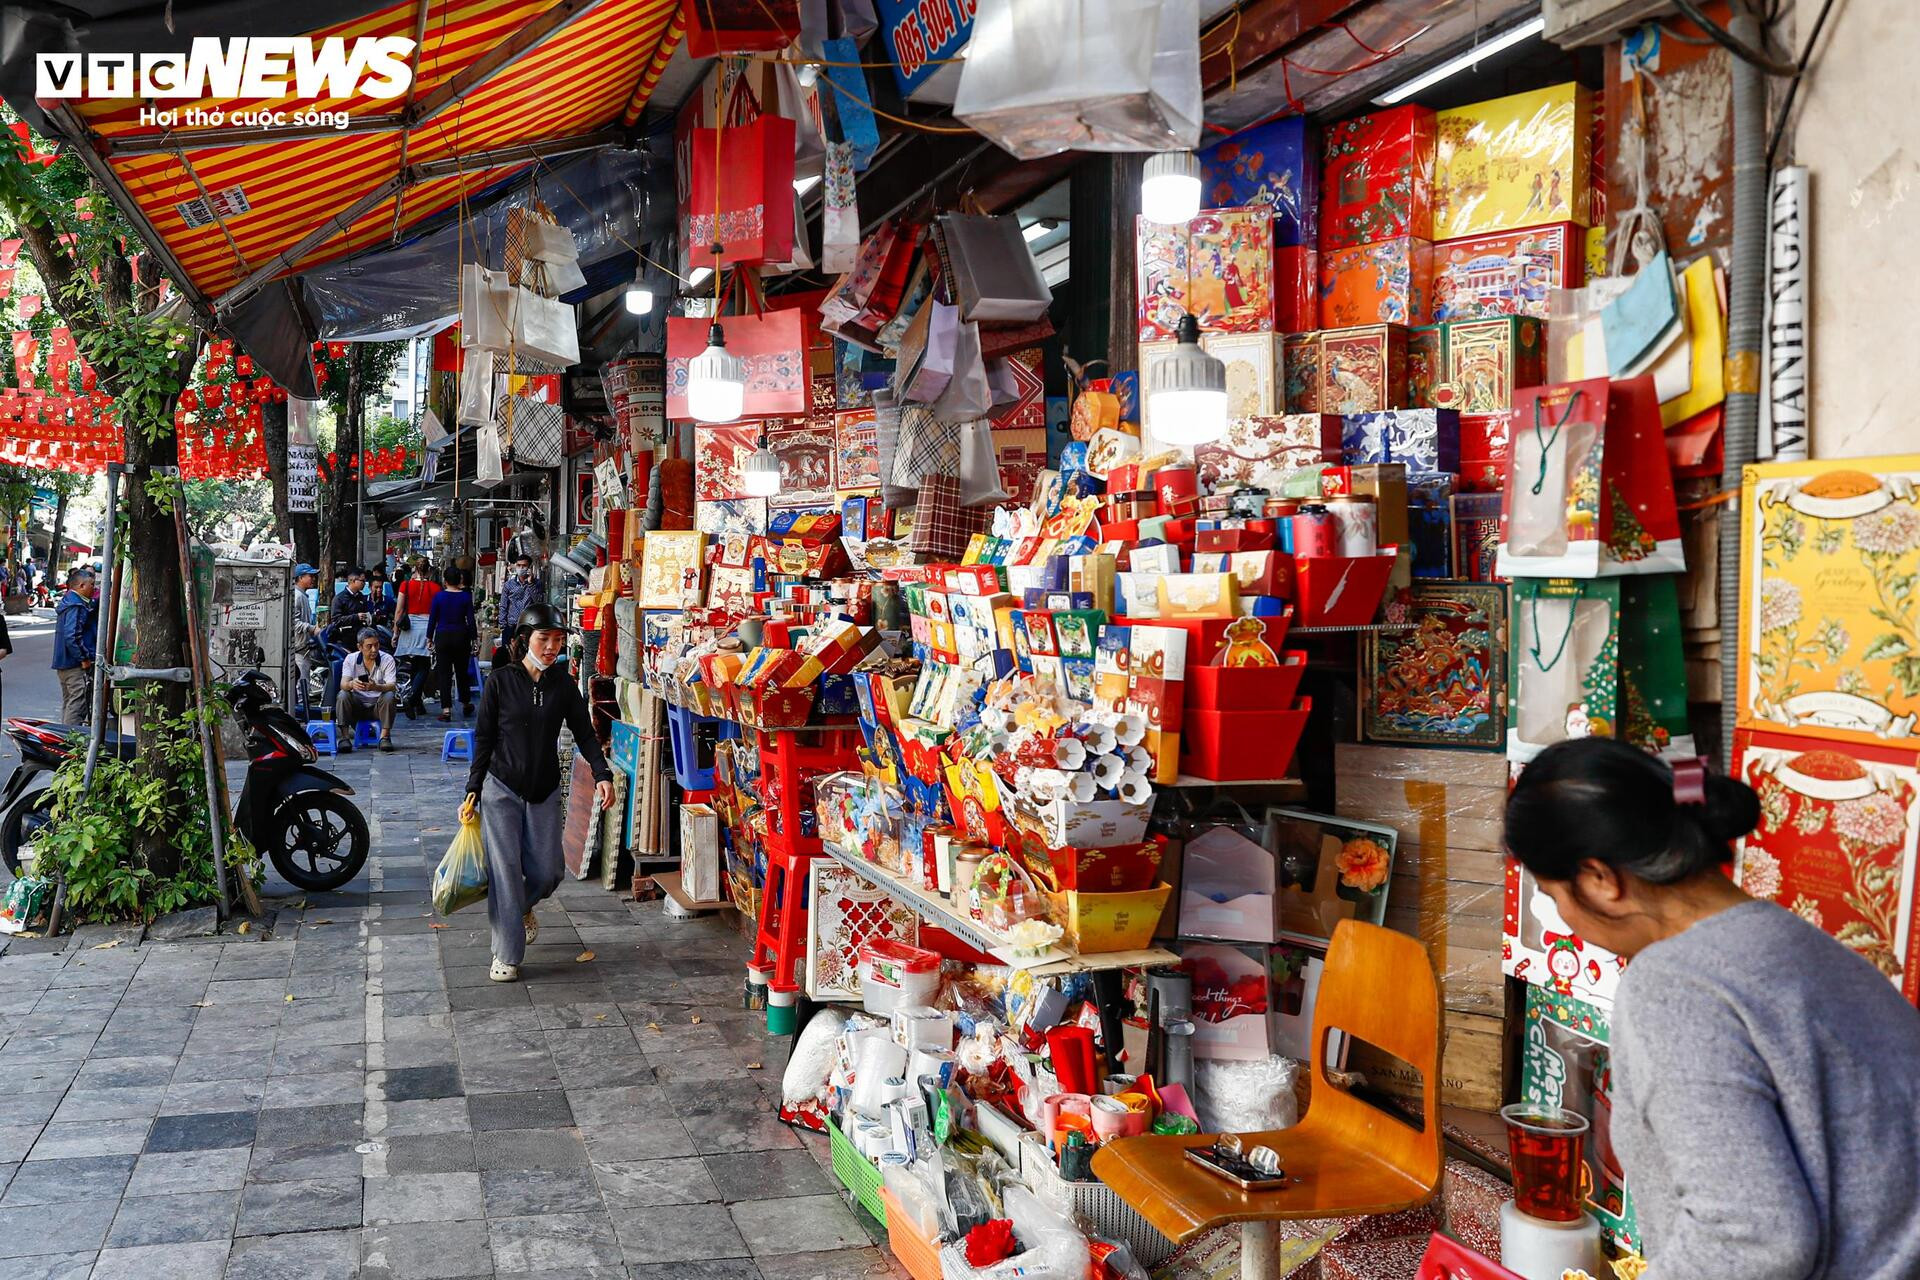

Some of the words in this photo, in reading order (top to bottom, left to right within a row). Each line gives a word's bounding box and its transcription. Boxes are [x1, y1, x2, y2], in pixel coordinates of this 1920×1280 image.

[893, 9, 927, 79] 085
[919, 0, 957, 54] 304
[1399, 1069, 1464, 1090] MANO
